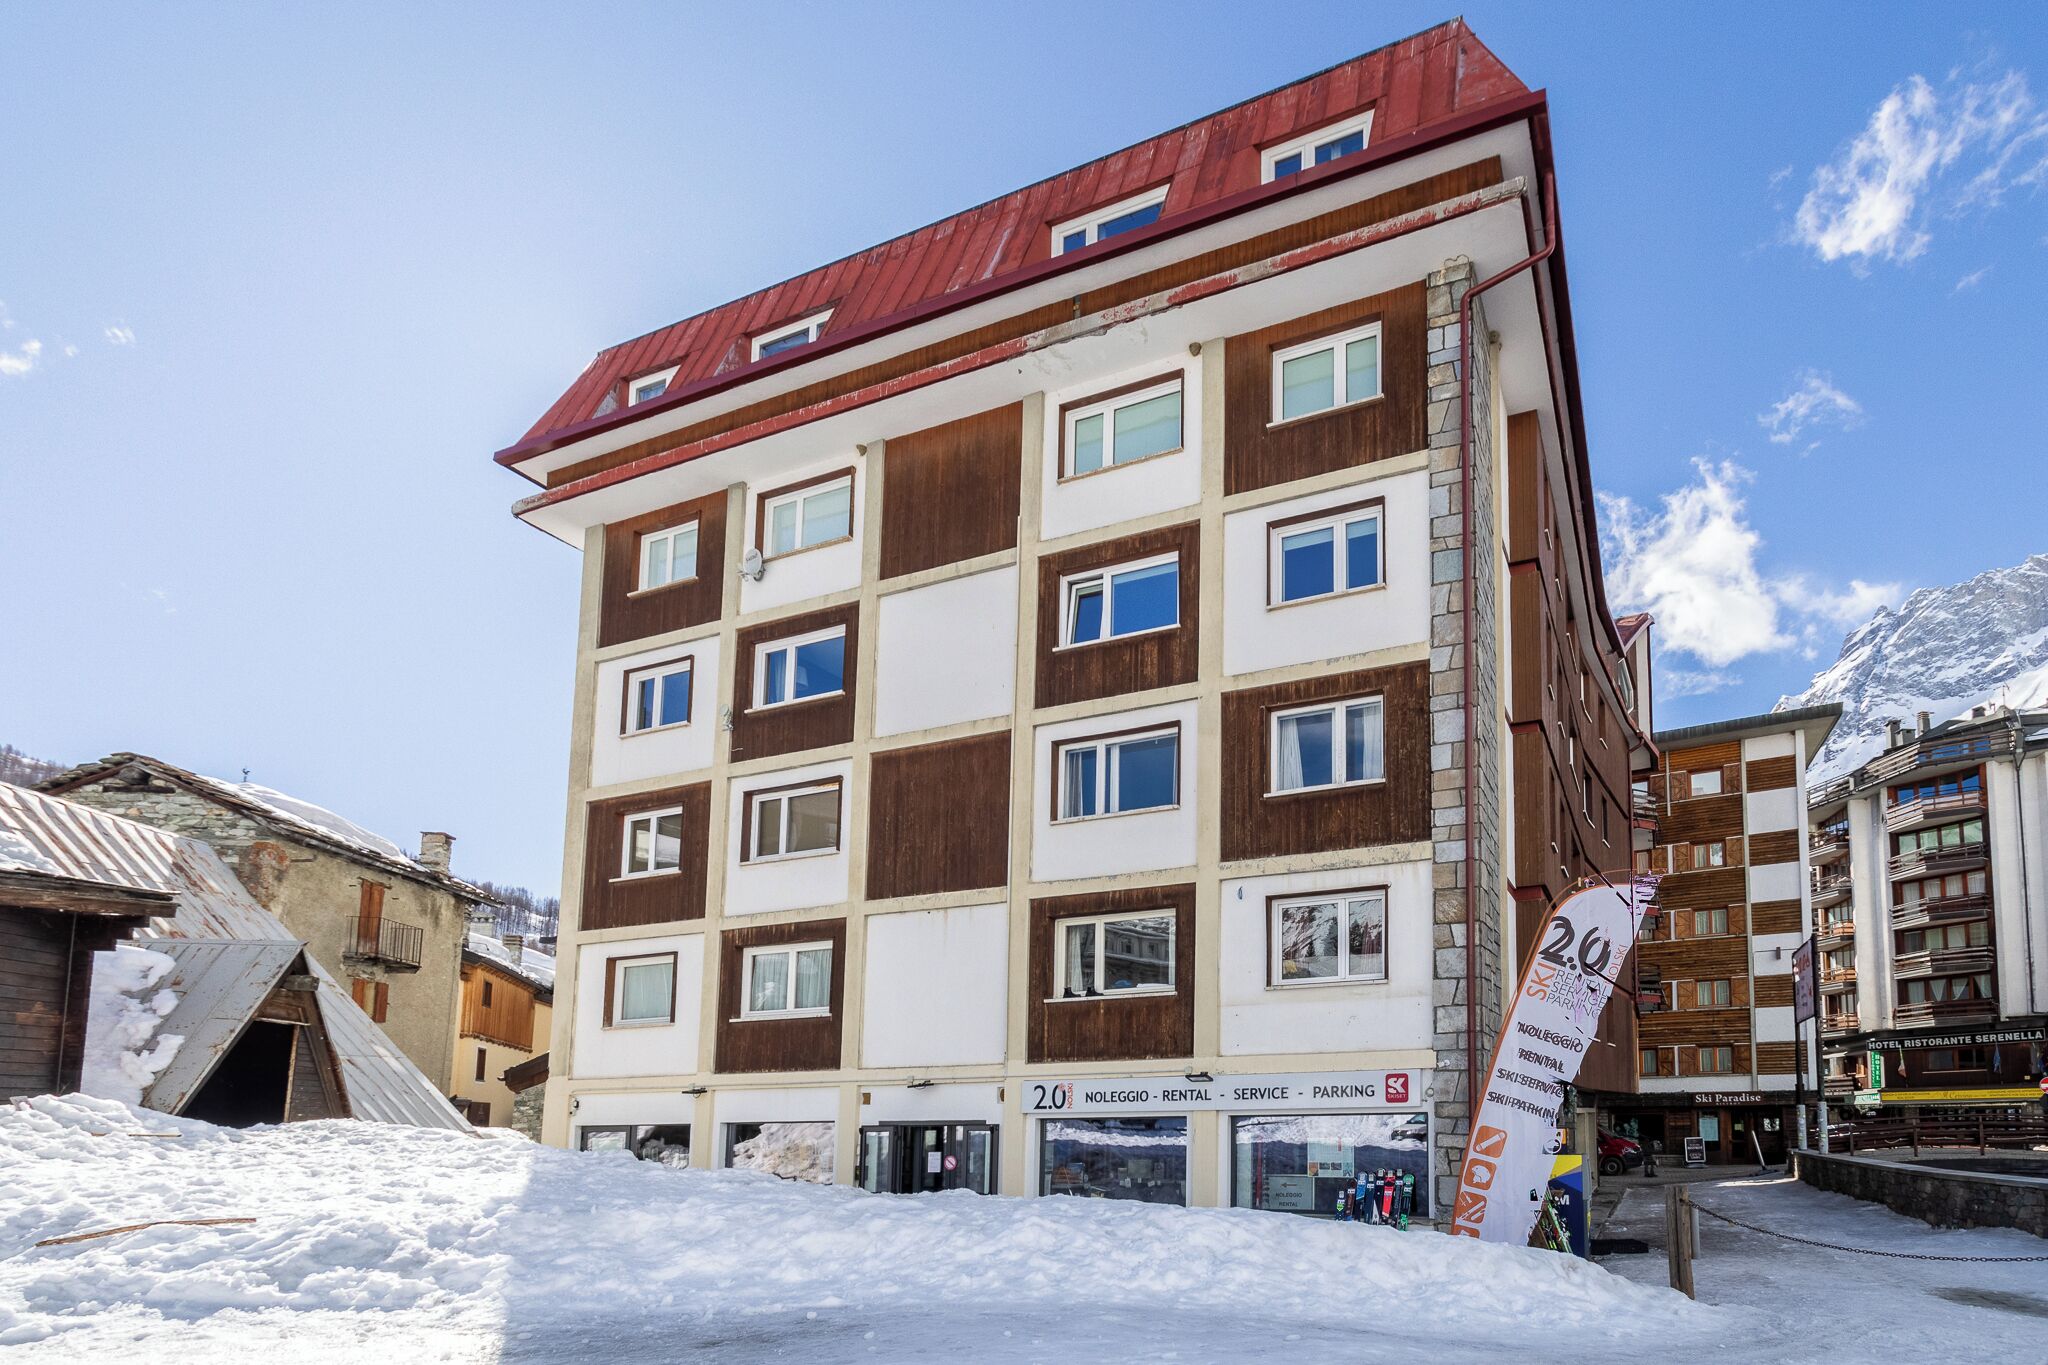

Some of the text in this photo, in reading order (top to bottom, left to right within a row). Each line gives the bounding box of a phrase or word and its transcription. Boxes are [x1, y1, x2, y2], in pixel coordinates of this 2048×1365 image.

[1526, 962, 1557, 1001] SKI
[1517, 1021, 1584, 1053] NOLEGGIO
[1868, 1031, 2043, 1050] HOTEL RISTORANTE SERENELLA
[1518, 1047, 1565, 1074] RENTAL
[1085, 1090, 1149, 1103] NOLEGGIO
[1162, 1089, 1212, 1101] RENTAL
[1233, 1087, 1289, 1100] SERVICE
[1313, 1084, 1375, 1098] PARKING
[1496, 1067, 1564, 1098] SKI SERVIC
[1033, 1084, 1066, 1110] 2.0
[1487, 1091, 1560, 1120] SKI PARKIN
[1695, 1092, 1761, 1103] Ski Paradise
